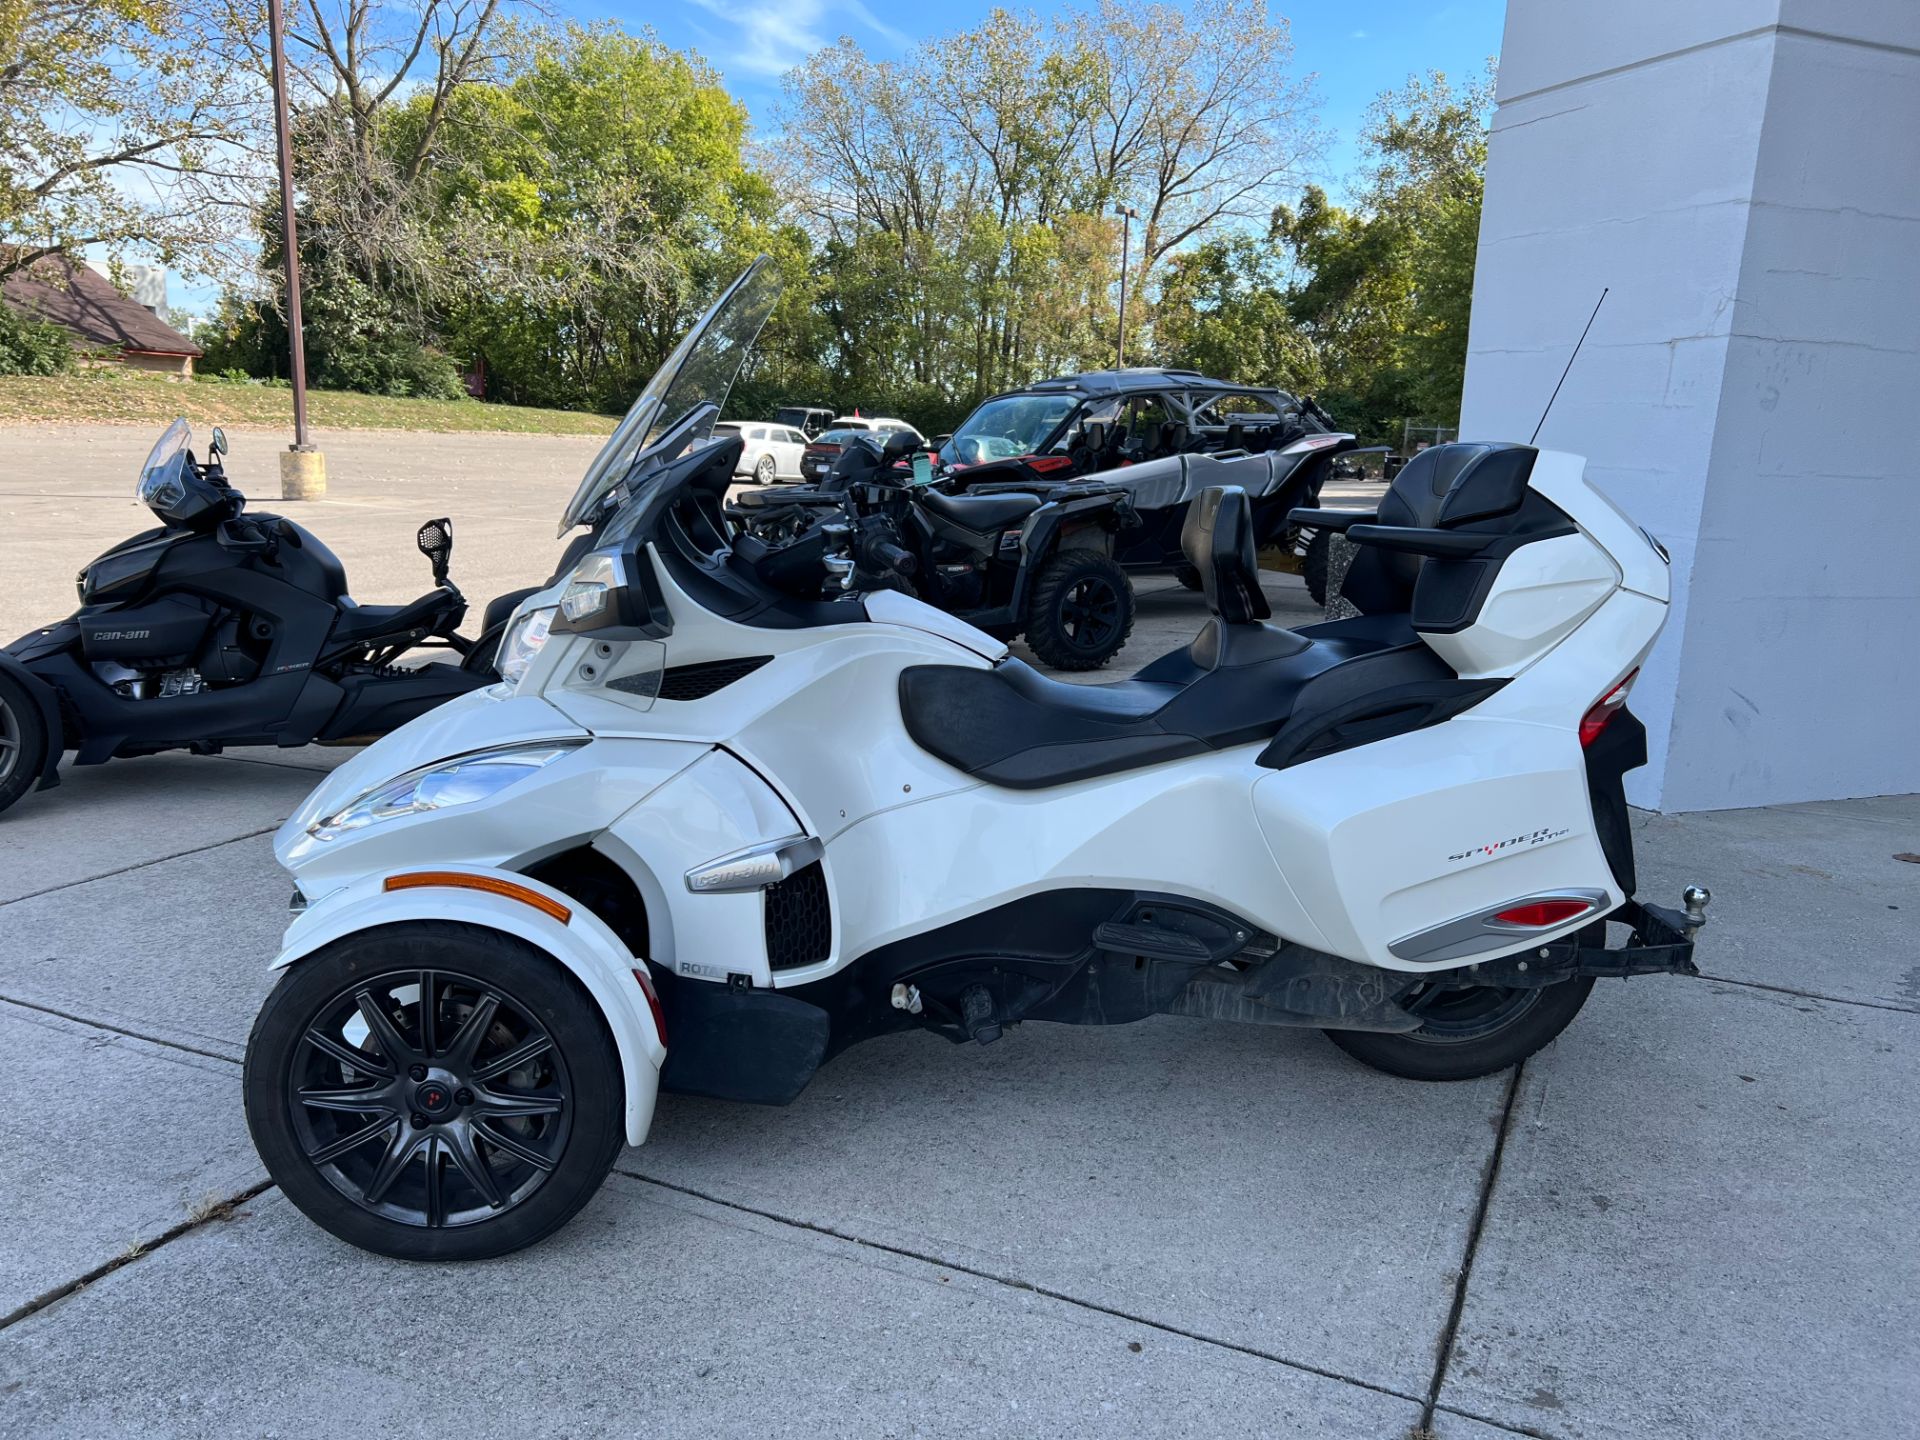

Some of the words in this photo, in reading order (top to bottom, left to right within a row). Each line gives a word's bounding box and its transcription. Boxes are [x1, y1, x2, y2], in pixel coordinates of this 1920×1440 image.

[93, 630, 150, 641] can-am
[1447, 827, 1550, 863] SPYDER
[695, 864, 776, 888] can-am
